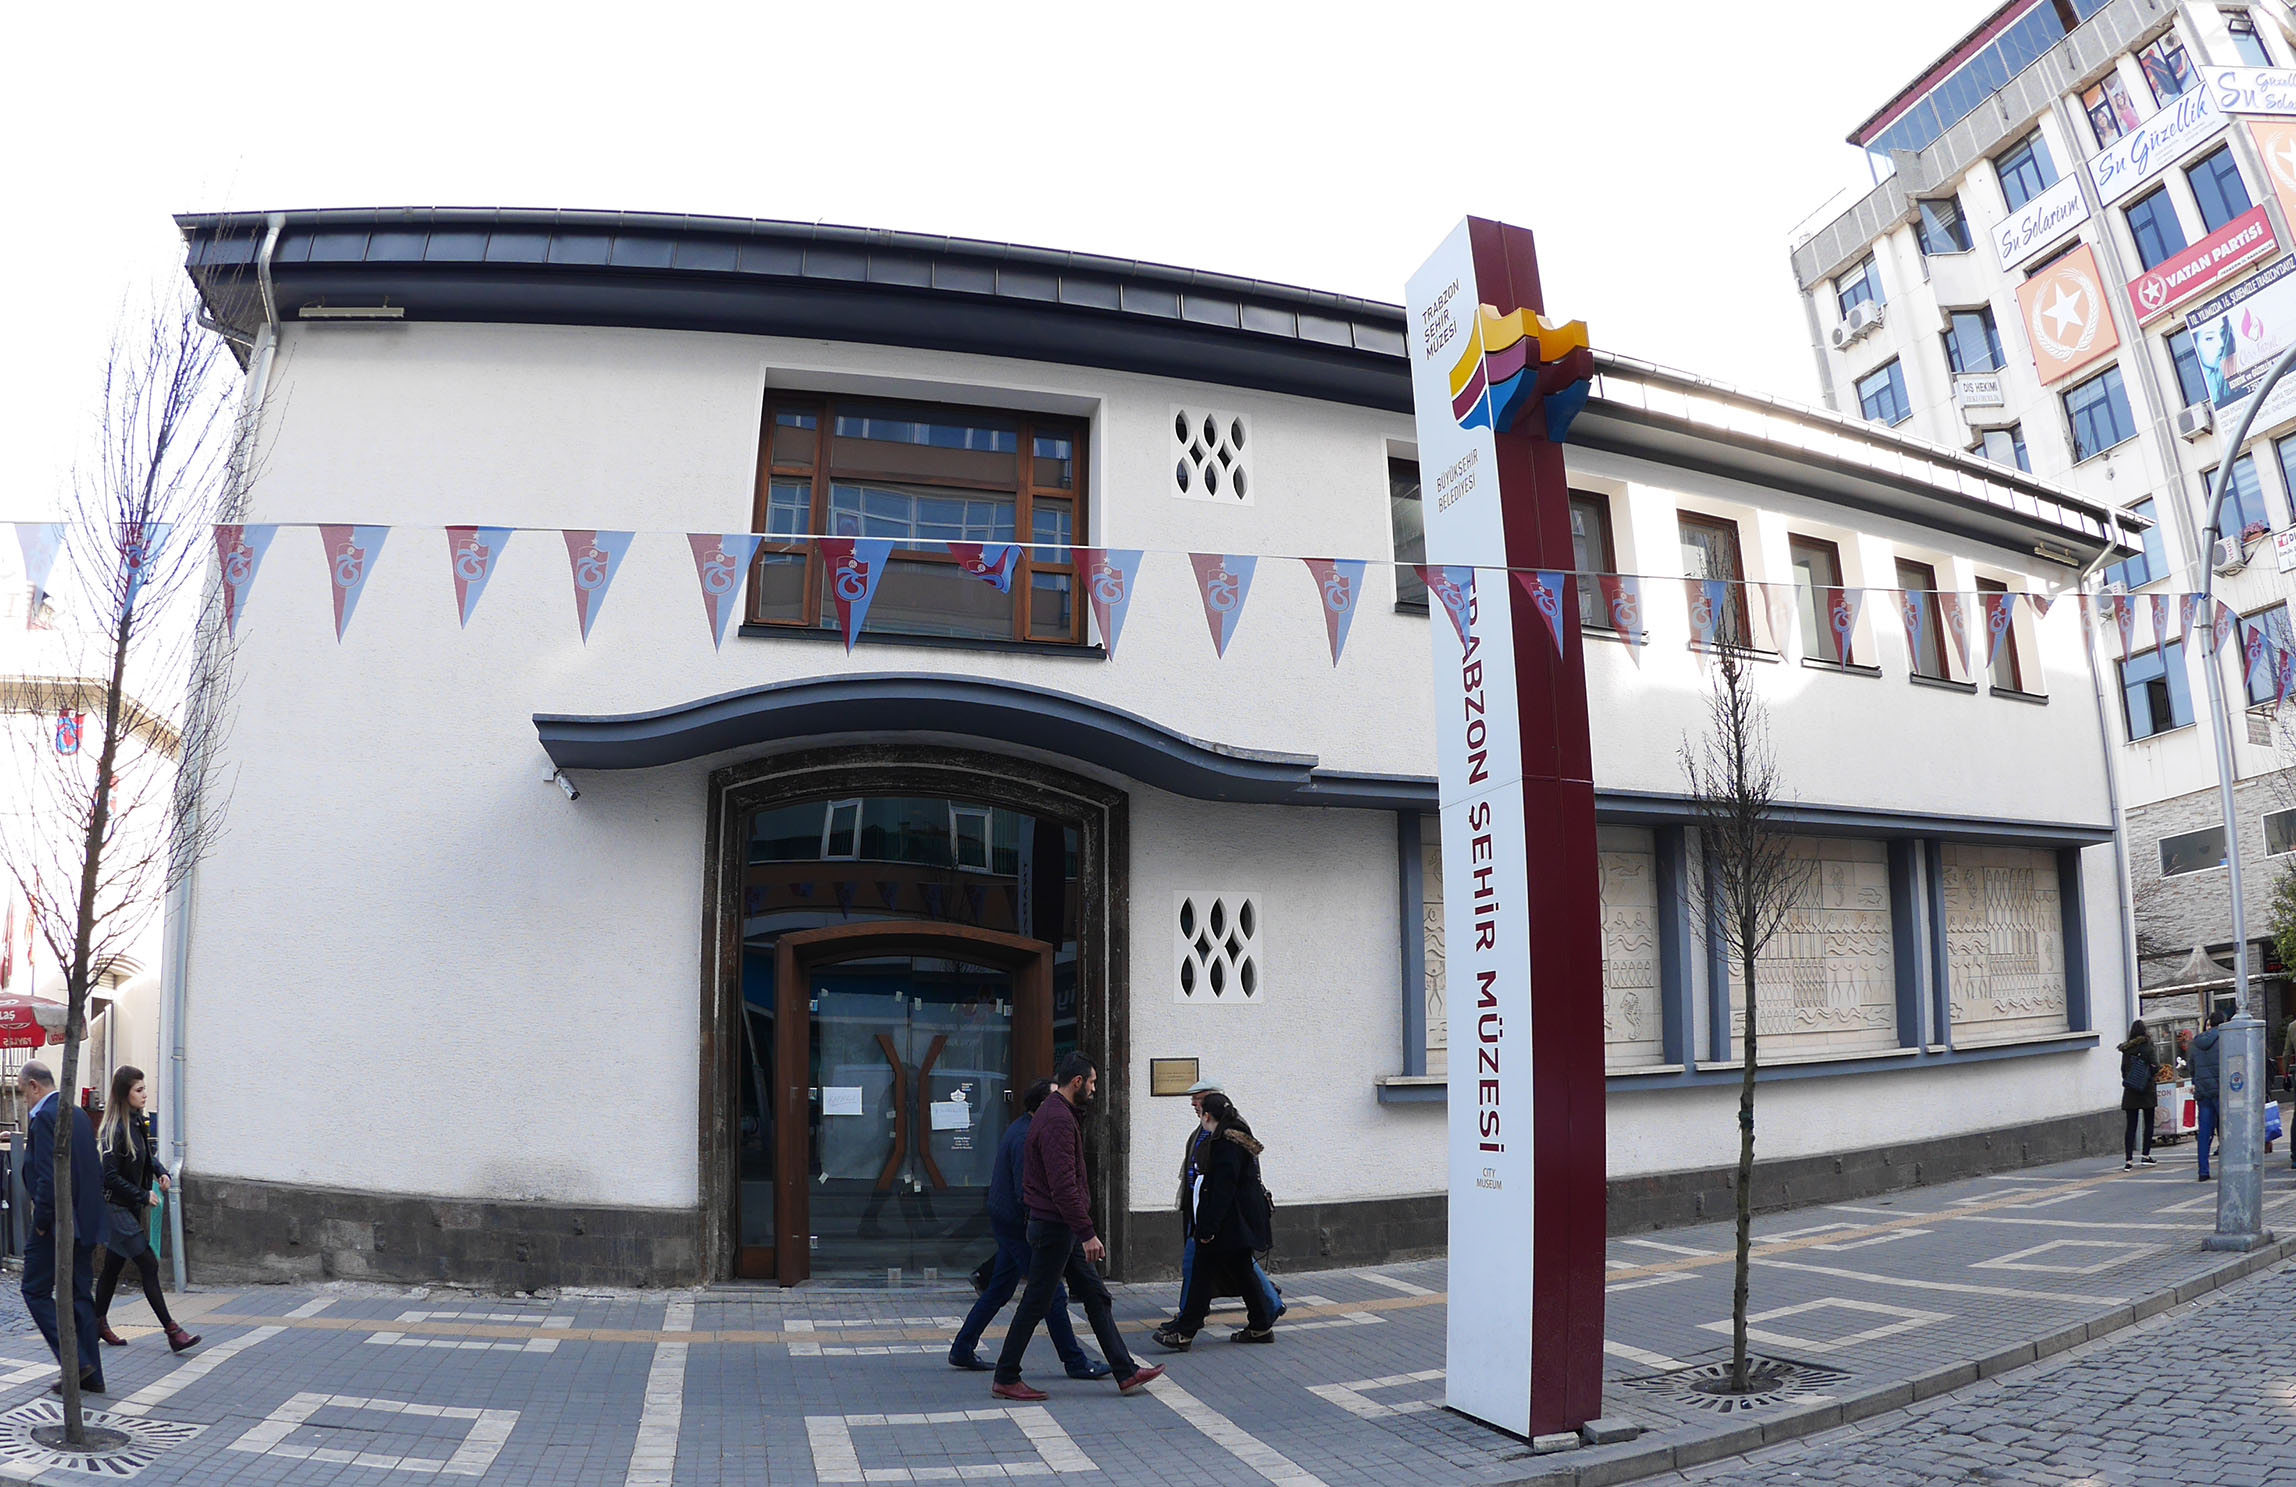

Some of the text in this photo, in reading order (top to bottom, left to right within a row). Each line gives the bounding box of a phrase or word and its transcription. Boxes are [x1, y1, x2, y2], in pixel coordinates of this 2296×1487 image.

[2218, 71, 2260, 108] Su
[2099, 152, 2126, 186] Su
[2130, 83, 2208, 176] Güzellik
[2002, 195, 2080, 259] Su Solarium
[2165, 221, 2264, 288] VATAN PARTİSİ
[1422, 277, 1460, 325] TRABZON
[1468, 801, 1499, 952] ŞEHİR
[1476, 970, 1505, 1153] MÜZESİ
[1476, 1177, 1503, 1190] MUSEUM
[1482, 1167, 1496, 1178] CITY
